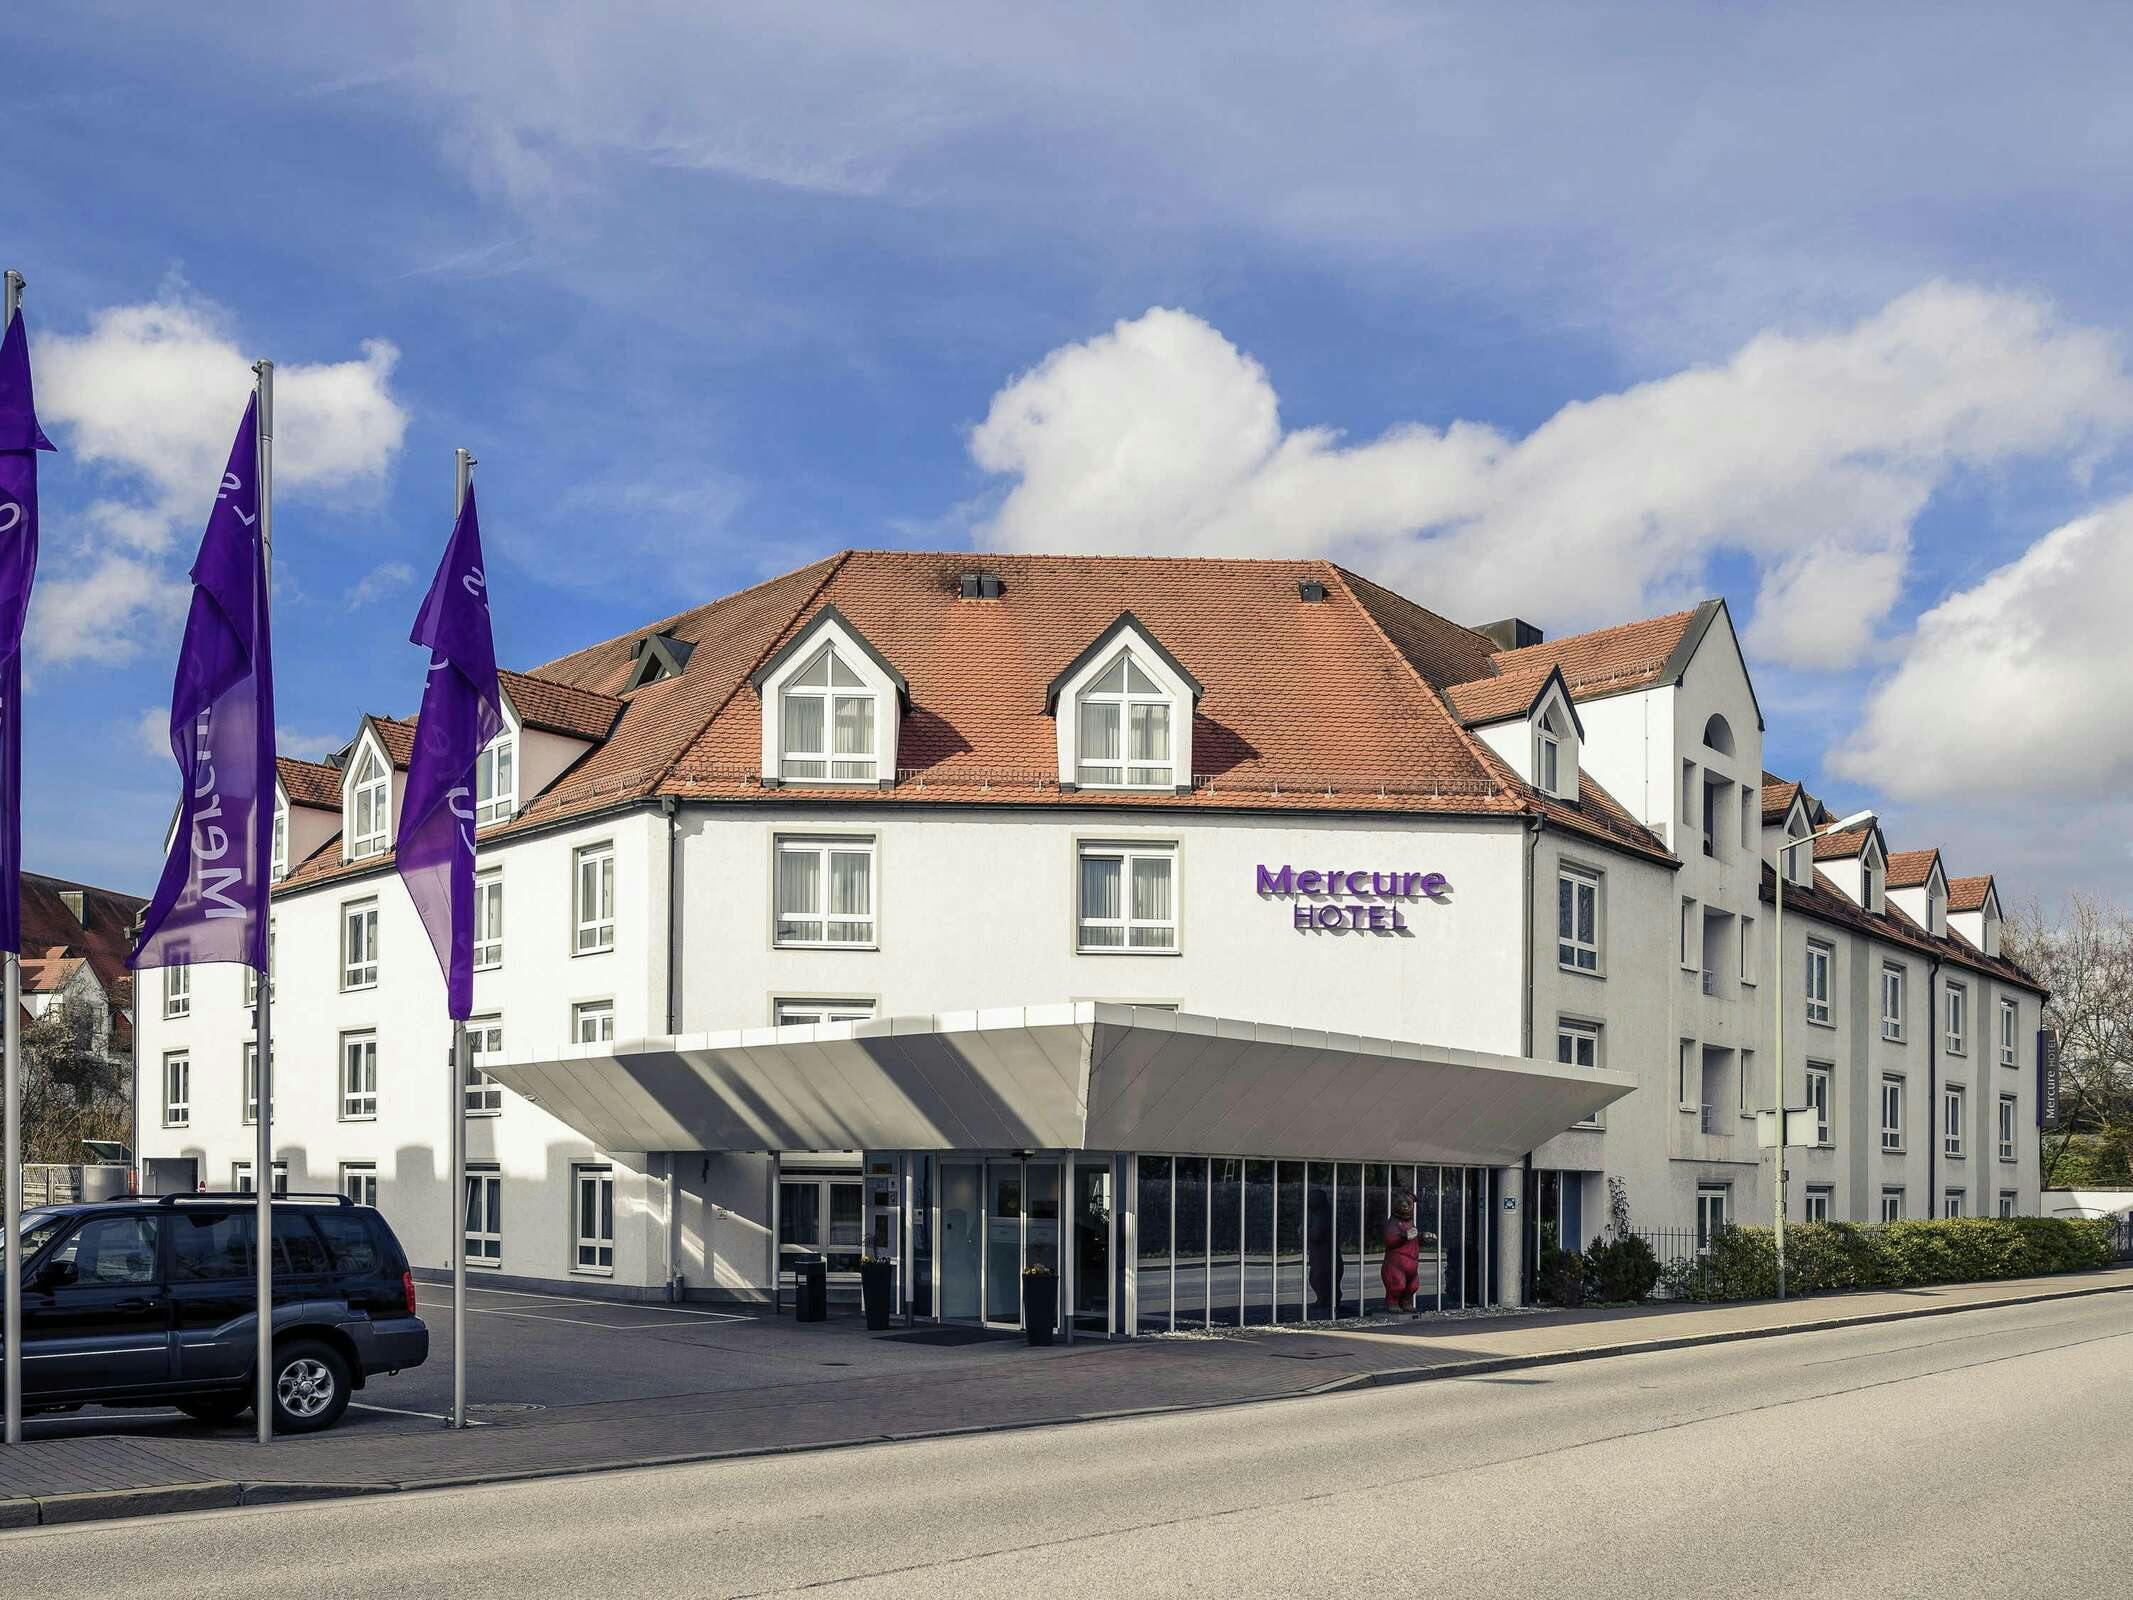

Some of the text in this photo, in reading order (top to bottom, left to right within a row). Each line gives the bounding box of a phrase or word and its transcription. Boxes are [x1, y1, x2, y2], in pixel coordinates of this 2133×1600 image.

[1256, 864, 1447, 897] Mercure
[1294, 904, 1408, 930] HOTEL
[2045, 1036, 2056, 1119] Mercure HOTEL
